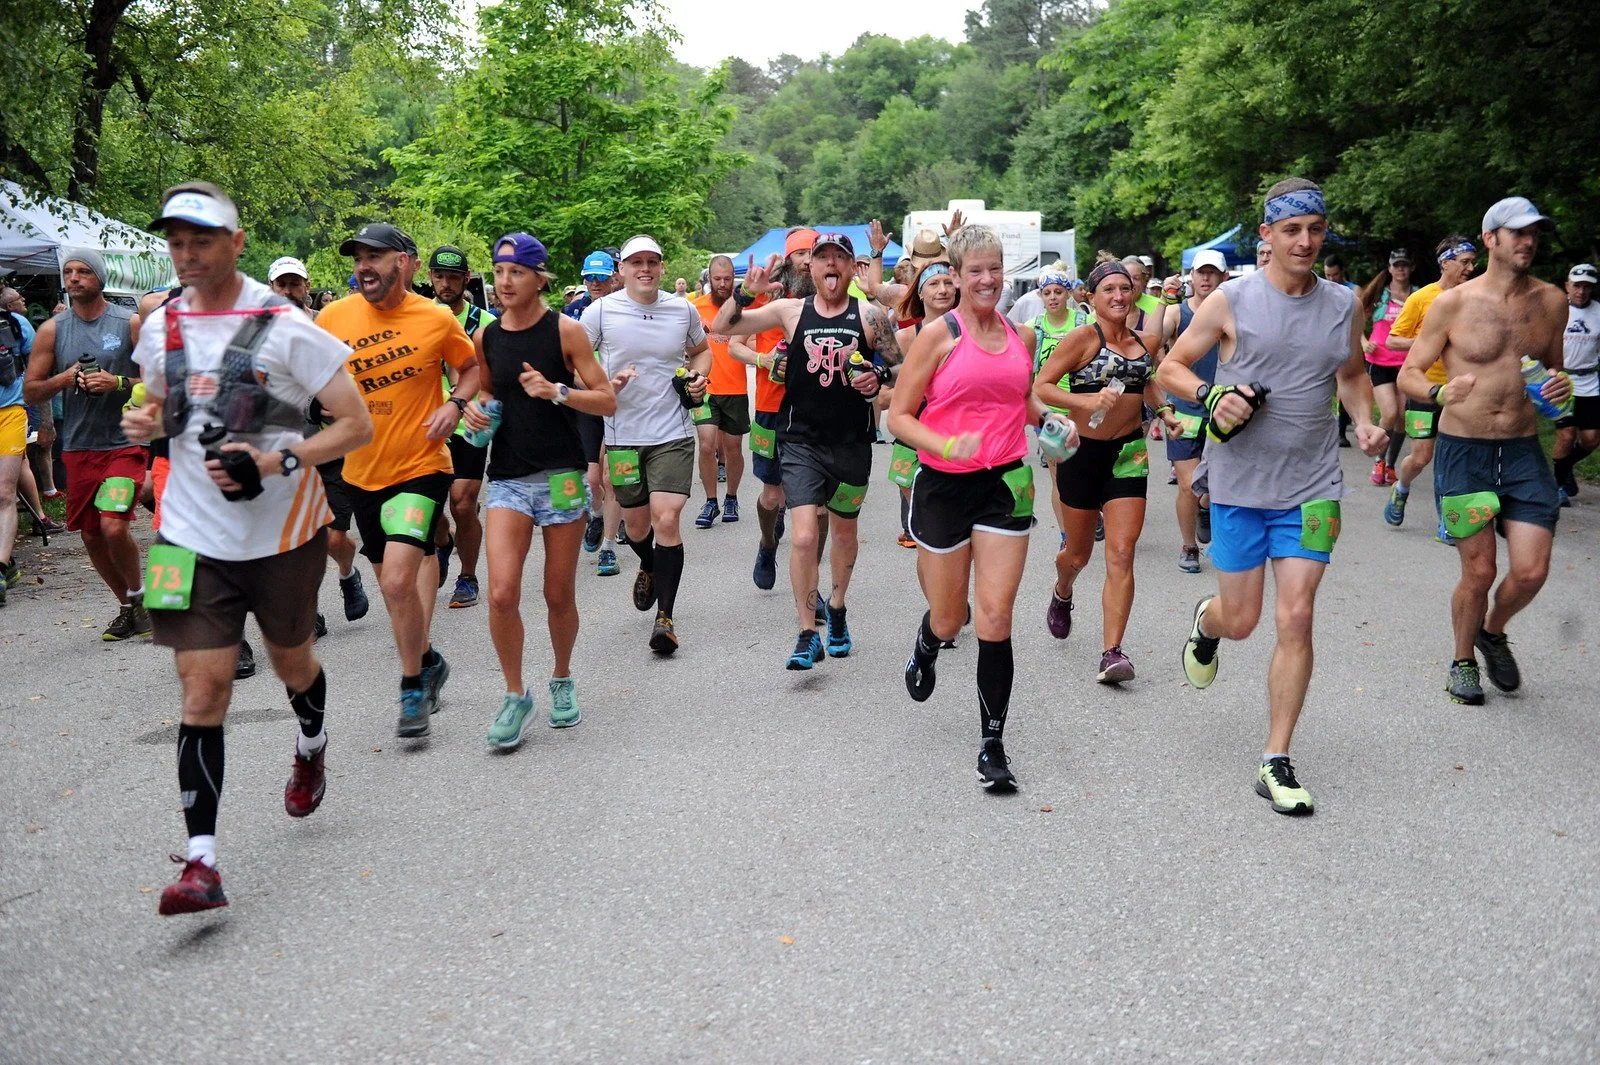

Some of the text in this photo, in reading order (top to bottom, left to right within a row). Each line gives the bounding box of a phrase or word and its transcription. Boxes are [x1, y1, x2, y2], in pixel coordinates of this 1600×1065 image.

[130, 255, 156, 291] RUN
[349, 345, 418, 374] Train.
[360, 366, 423, 394] Race.
[615, 461, 634, 476] 20
[893, 458, 912, 475] 62
[563, 478, 577, 496] 8
[1467, 505, 1494, 524] 33
[151, 565, 182, 590] 73
